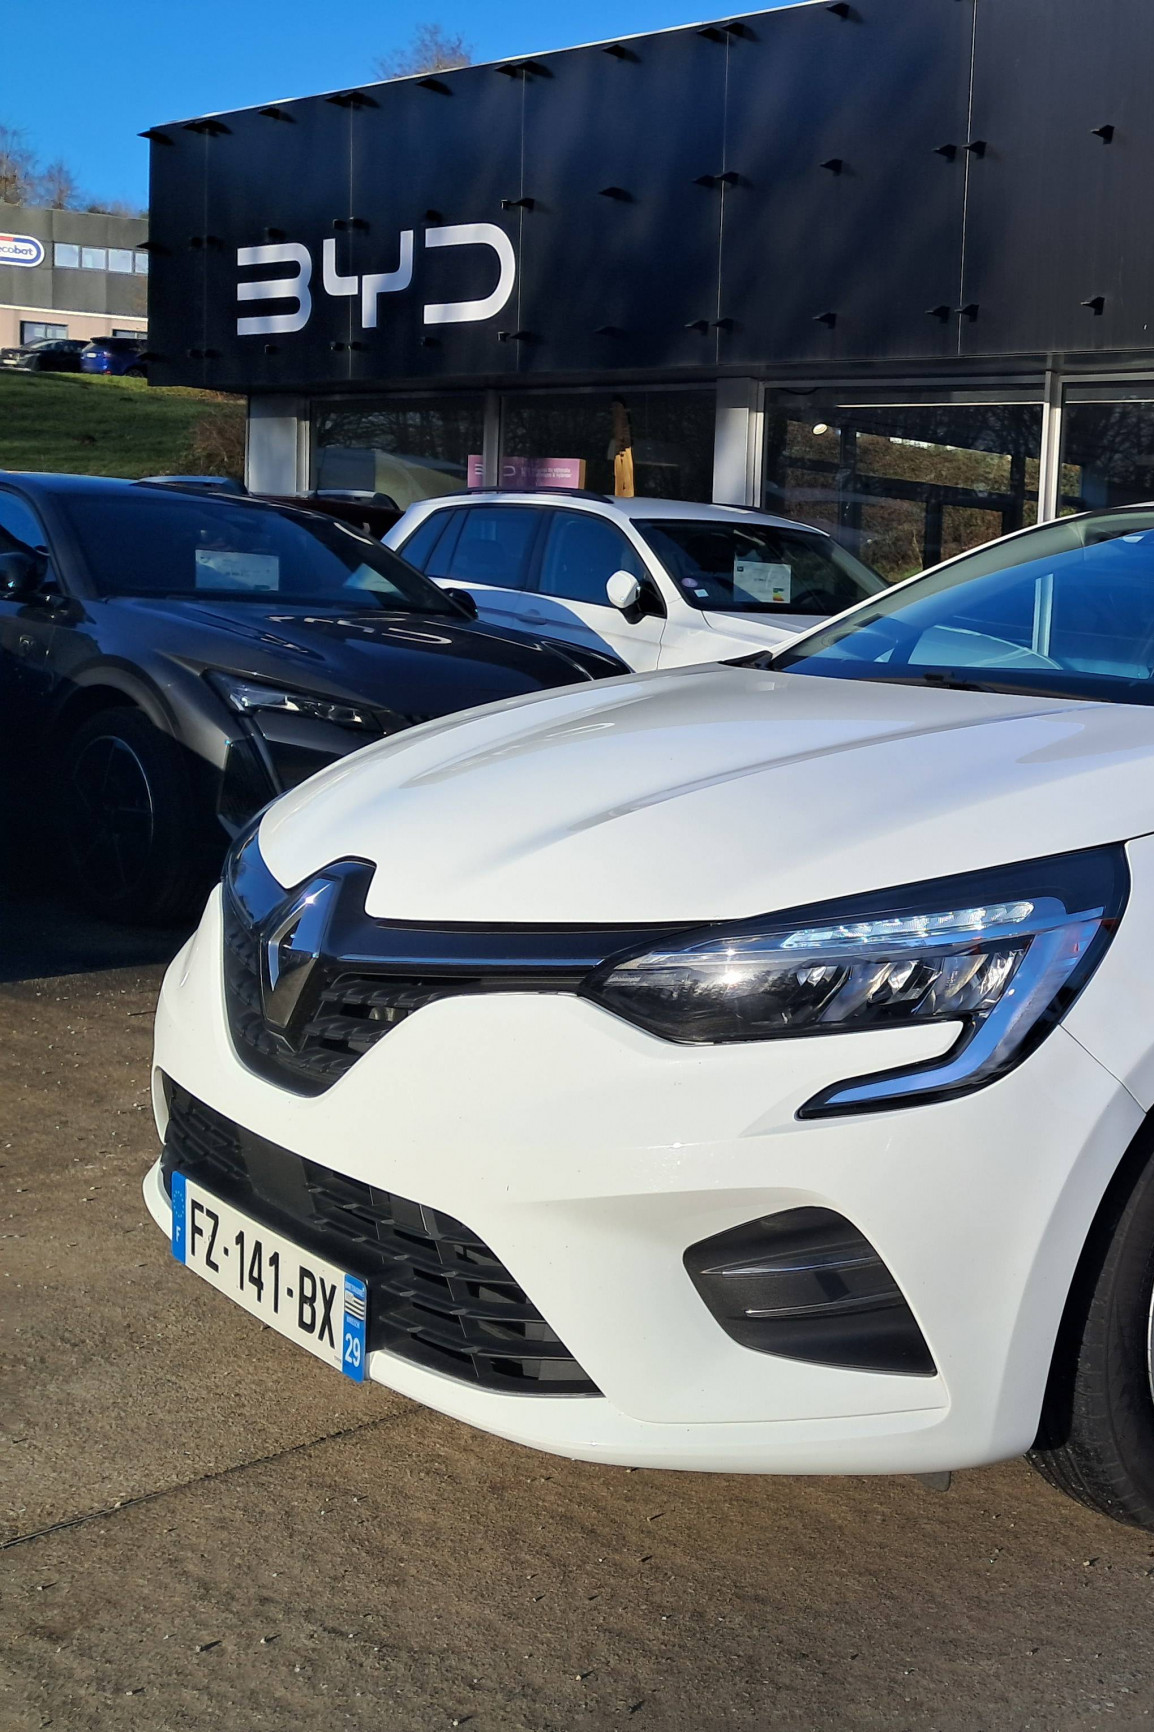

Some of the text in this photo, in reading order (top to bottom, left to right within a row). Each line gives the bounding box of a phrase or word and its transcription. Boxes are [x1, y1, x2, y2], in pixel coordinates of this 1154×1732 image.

[237, 222, 516, 336] BYD
[176, 1225, 182, 1243] F
[191, 1198, 337, 1350] FZ-141-BX
[344, 1333, 361, 1368] 29
